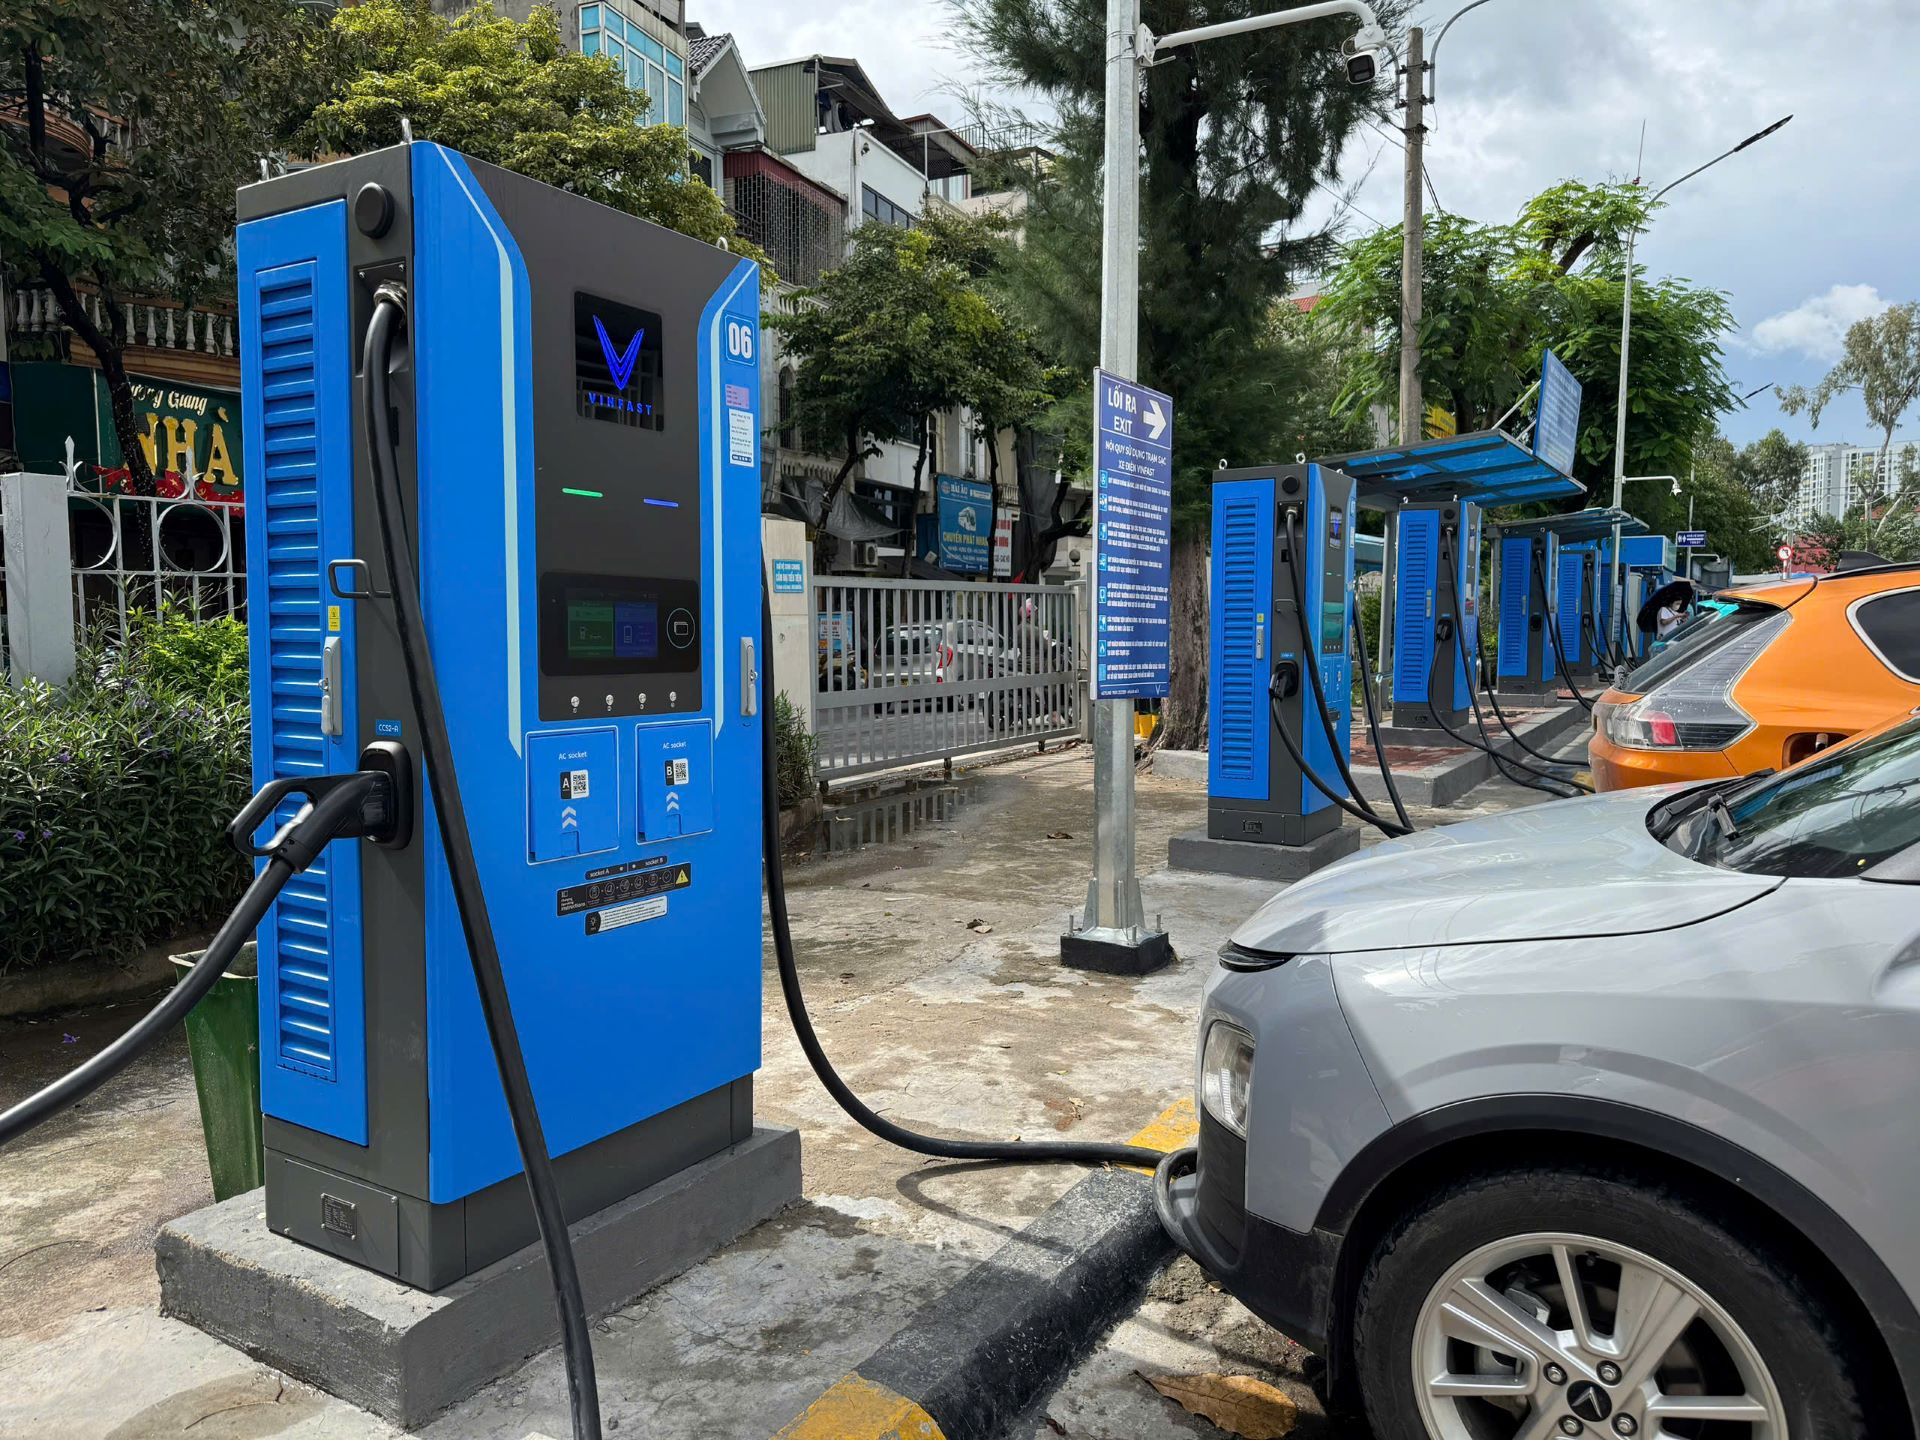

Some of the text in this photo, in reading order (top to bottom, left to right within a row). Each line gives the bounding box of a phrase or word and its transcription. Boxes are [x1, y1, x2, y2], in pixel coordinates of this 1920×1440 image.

[728, 322, 753, 359] 06
[168, 390, 208, 416] Giang
[588, 392, 653, 416] VINFAST
[1108, 384, 1137, 414] LỐI RA
[1113, 415, 1133, 434] EXIT
[1114, 443, 1125, 455] QUY
[1132, 448, 1145, 460] DỤNG
[1145, 451, 1158, 463] TRẠM
[1118, 459, 1155, 477] XE ĐIỆN VINFAST
[378, 724, 399, 732] CCS2-A
[670, 741, 687, 749] socket
[568, 751, 588, 759] socket
[666, 766, 673, 776] B
[562, 777, 570, 788] A
